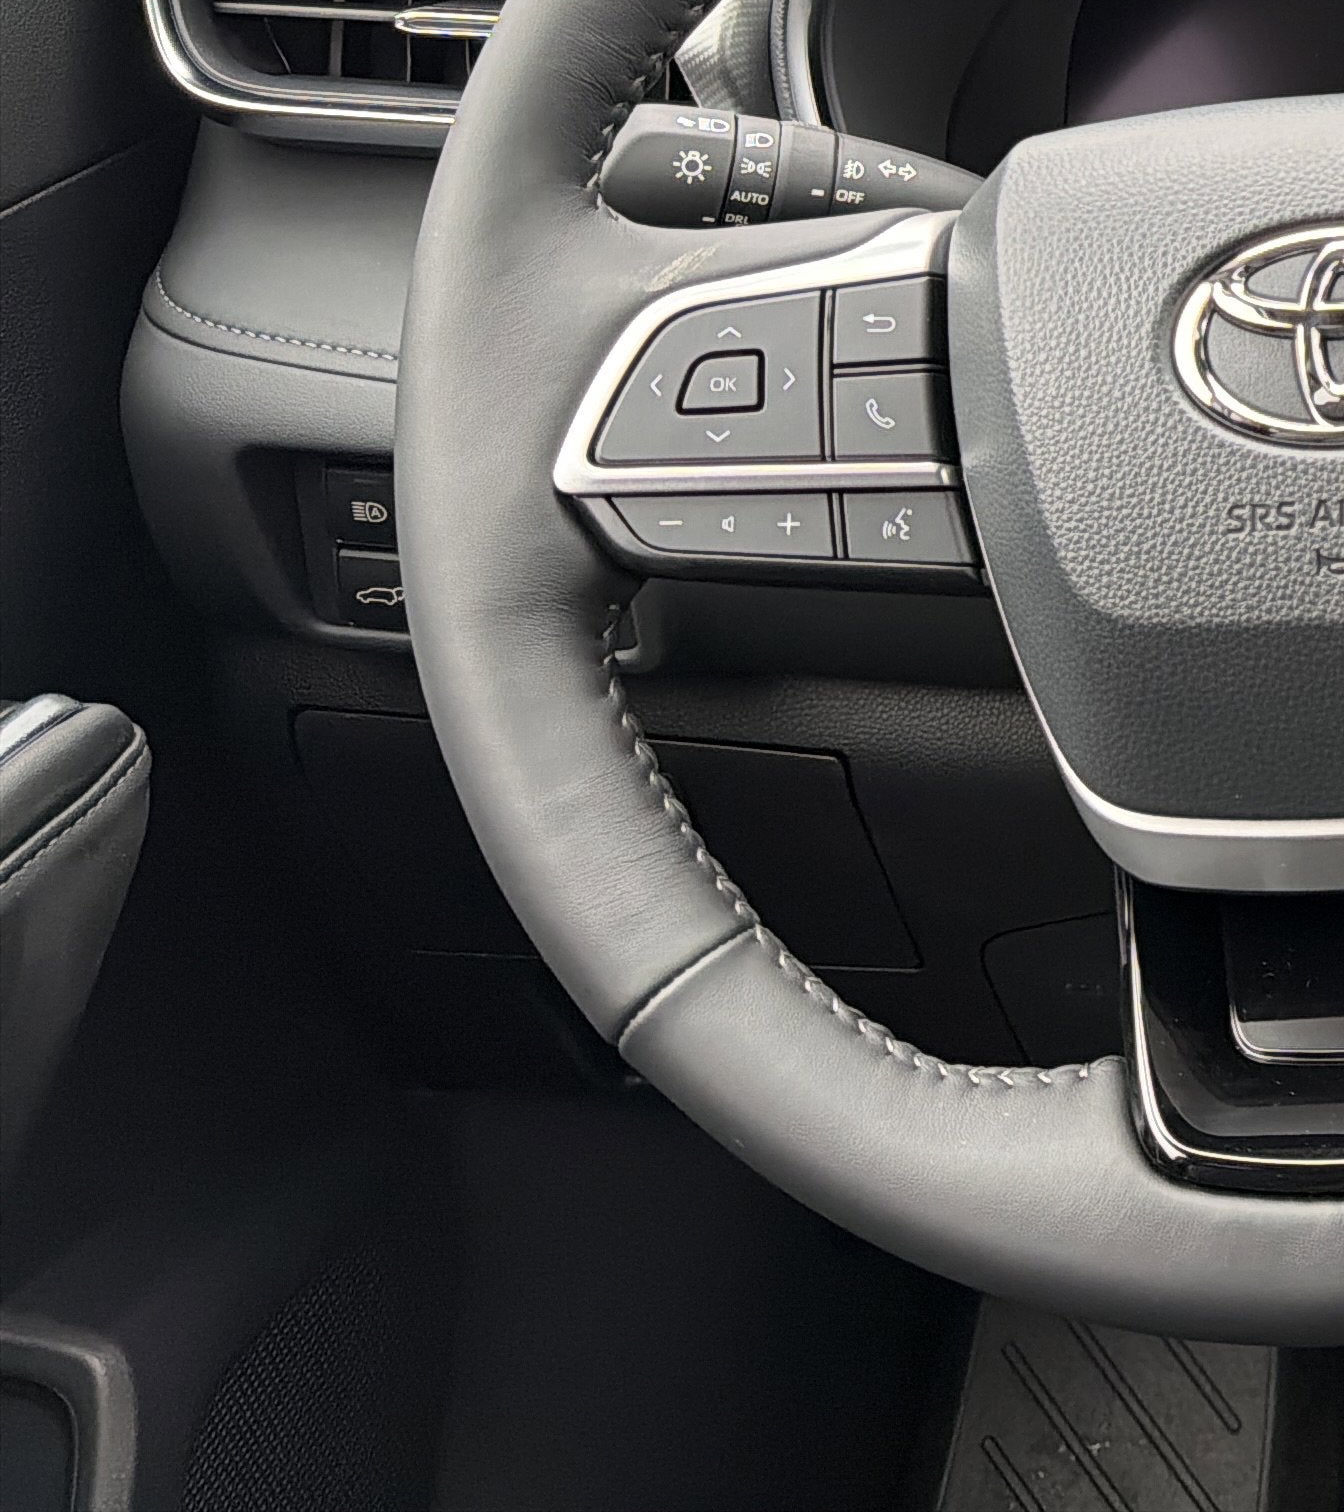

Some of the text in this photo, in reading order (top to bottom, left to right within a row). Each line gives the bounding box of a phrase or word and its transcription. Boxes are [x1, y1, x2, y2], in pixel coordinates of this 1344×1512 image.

[730, 190, 769, 206] AUTO
[836, 190, 865, 204] OFF
[725, 213, 749, 225] DRL
[710, 376, 737, 392] OK
[1226, 500, 1296, 534] SRS
